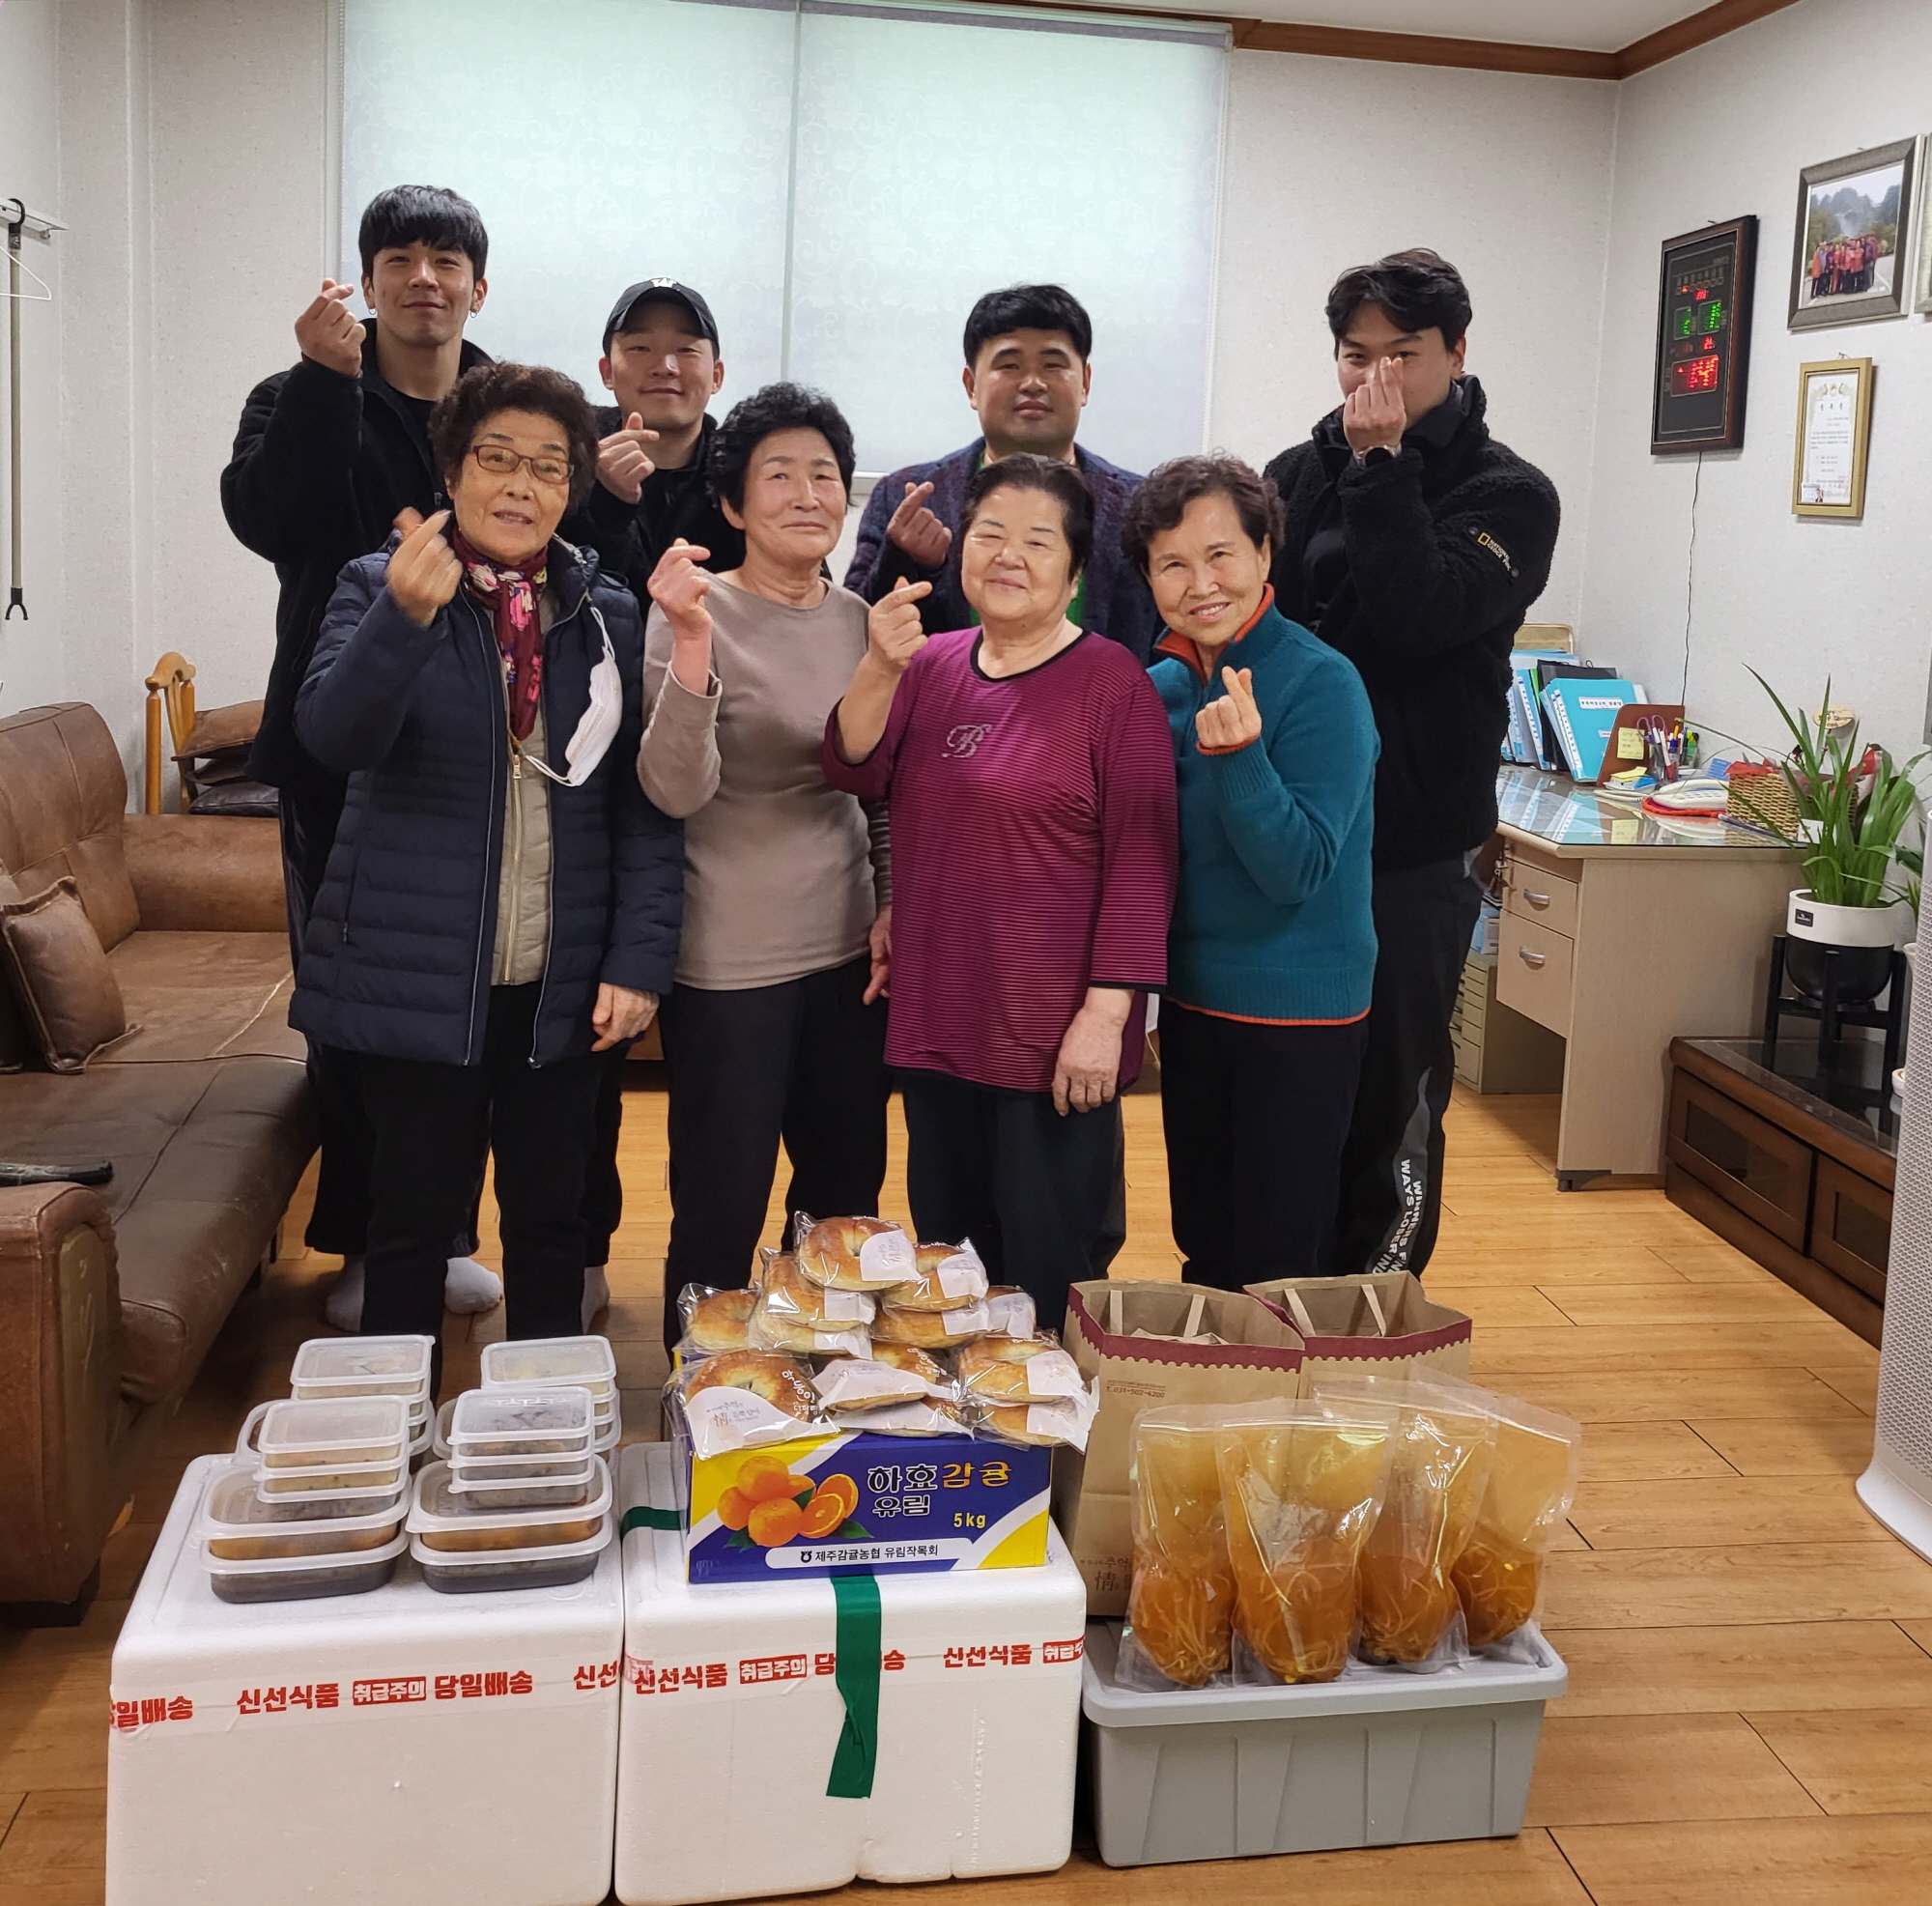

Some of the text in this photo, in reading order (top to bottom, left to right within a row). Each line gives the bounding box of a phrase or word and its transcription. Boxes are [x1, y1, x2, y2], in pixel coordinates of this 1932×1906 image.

[1401, 1159, 1415, 1207] WAYS
[1399, 1181, 1423, 1247] WINNERS
[1113, 1387, 1165, 1399] 031-502-4200
[872, 1494, 931, 1518] 유림
[815, 1545, 939, 1563] 제주감귤농협 유림작목회
[237, 1683, 340, 1716] 신선식품
[353, 1677, 427, 1705] 취급주의
[435, 1669, 533, 1698] 당일배송
[573, 1660, 618, 1691] 신선
[635, 1661, 728, 1694] 신선식품
[741, 1656, 807, 1684] 취급주의
[943, 1643, 1032, 1667] 신선식품
